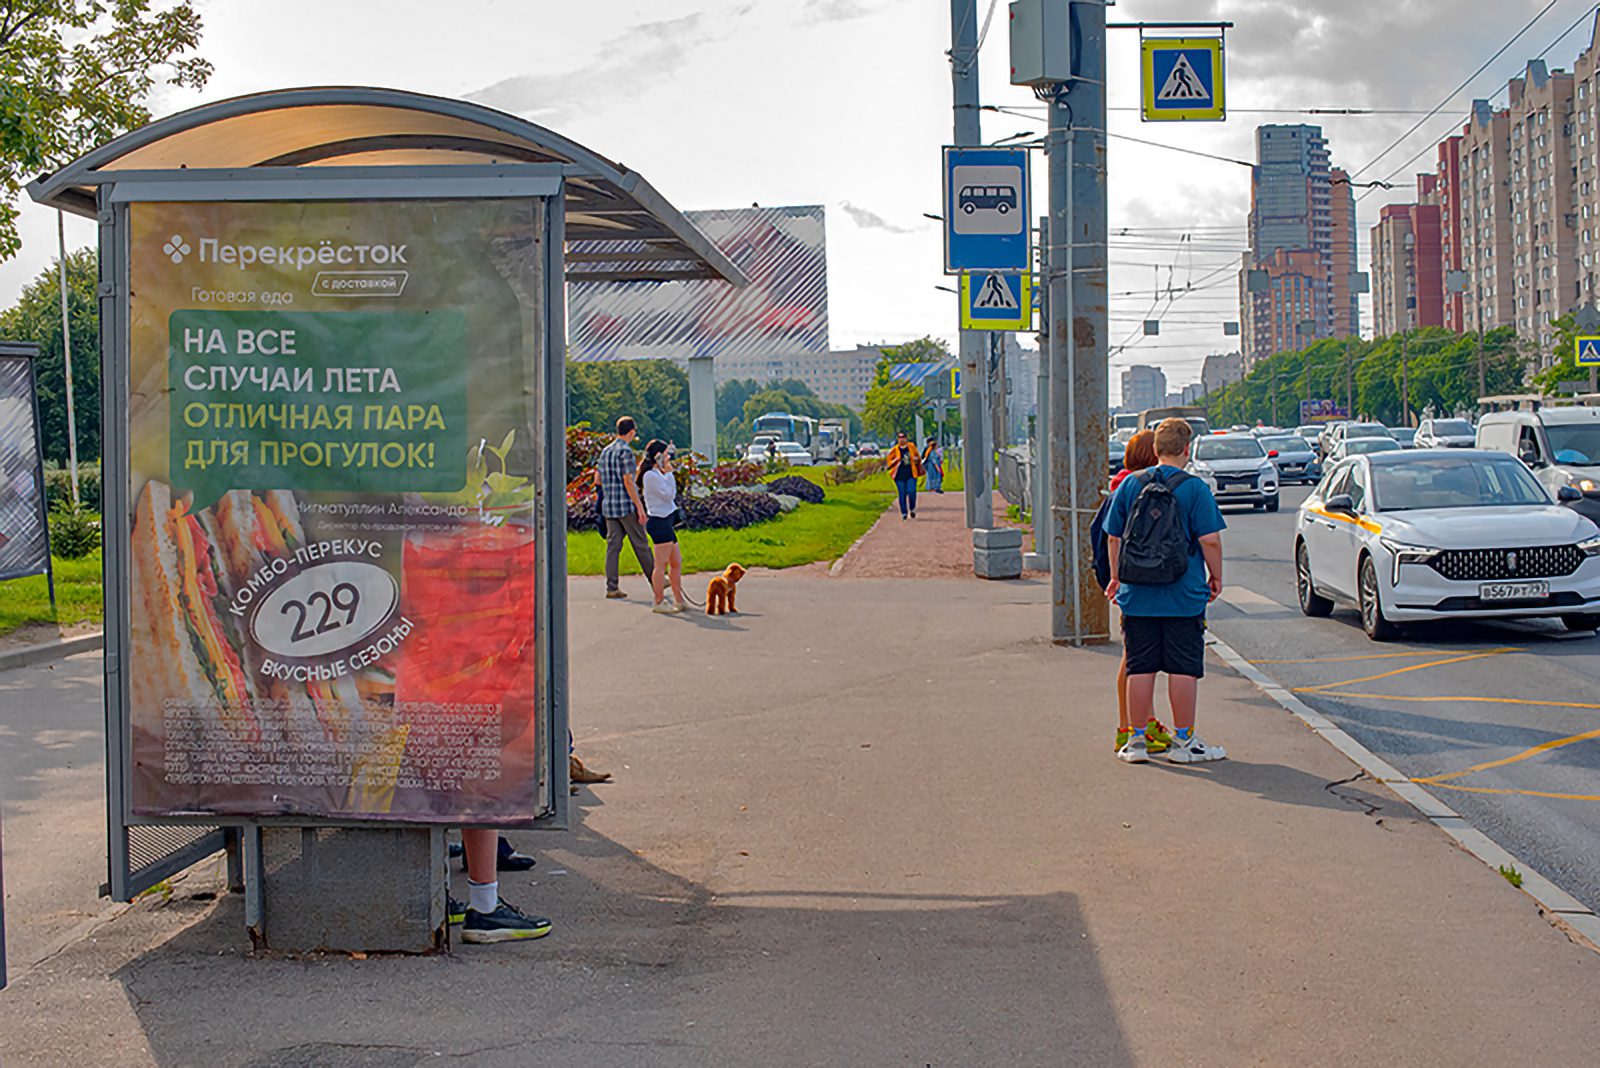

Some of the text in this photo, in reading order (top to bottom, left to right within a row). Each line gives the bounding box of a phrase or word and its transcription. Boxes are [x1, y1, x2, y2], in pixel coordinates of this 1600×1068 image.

[199, 238, 408, 270] Перекрёсток
[191, 287, 256, 303] Готовая
[331, 277, 397, 290] доставкой
[184, 329, 297, 356] НА ВСЕ
[183, 366, 402, 393] СЛУЧАИ ЛЕТА
[183, 402, 446, 431] ОТЛИЧНАЯ ПАРА
[185, 441, 435, 470] ДЛЯ ПРОГУЛОК!
[229, 539, 383, 616] КОМБО-ПЕРЕКУС
[280, 582, 360, 643] 229
[260, 616, 415, 682] ВКУСНЫЕ СЕЗОНЫ
